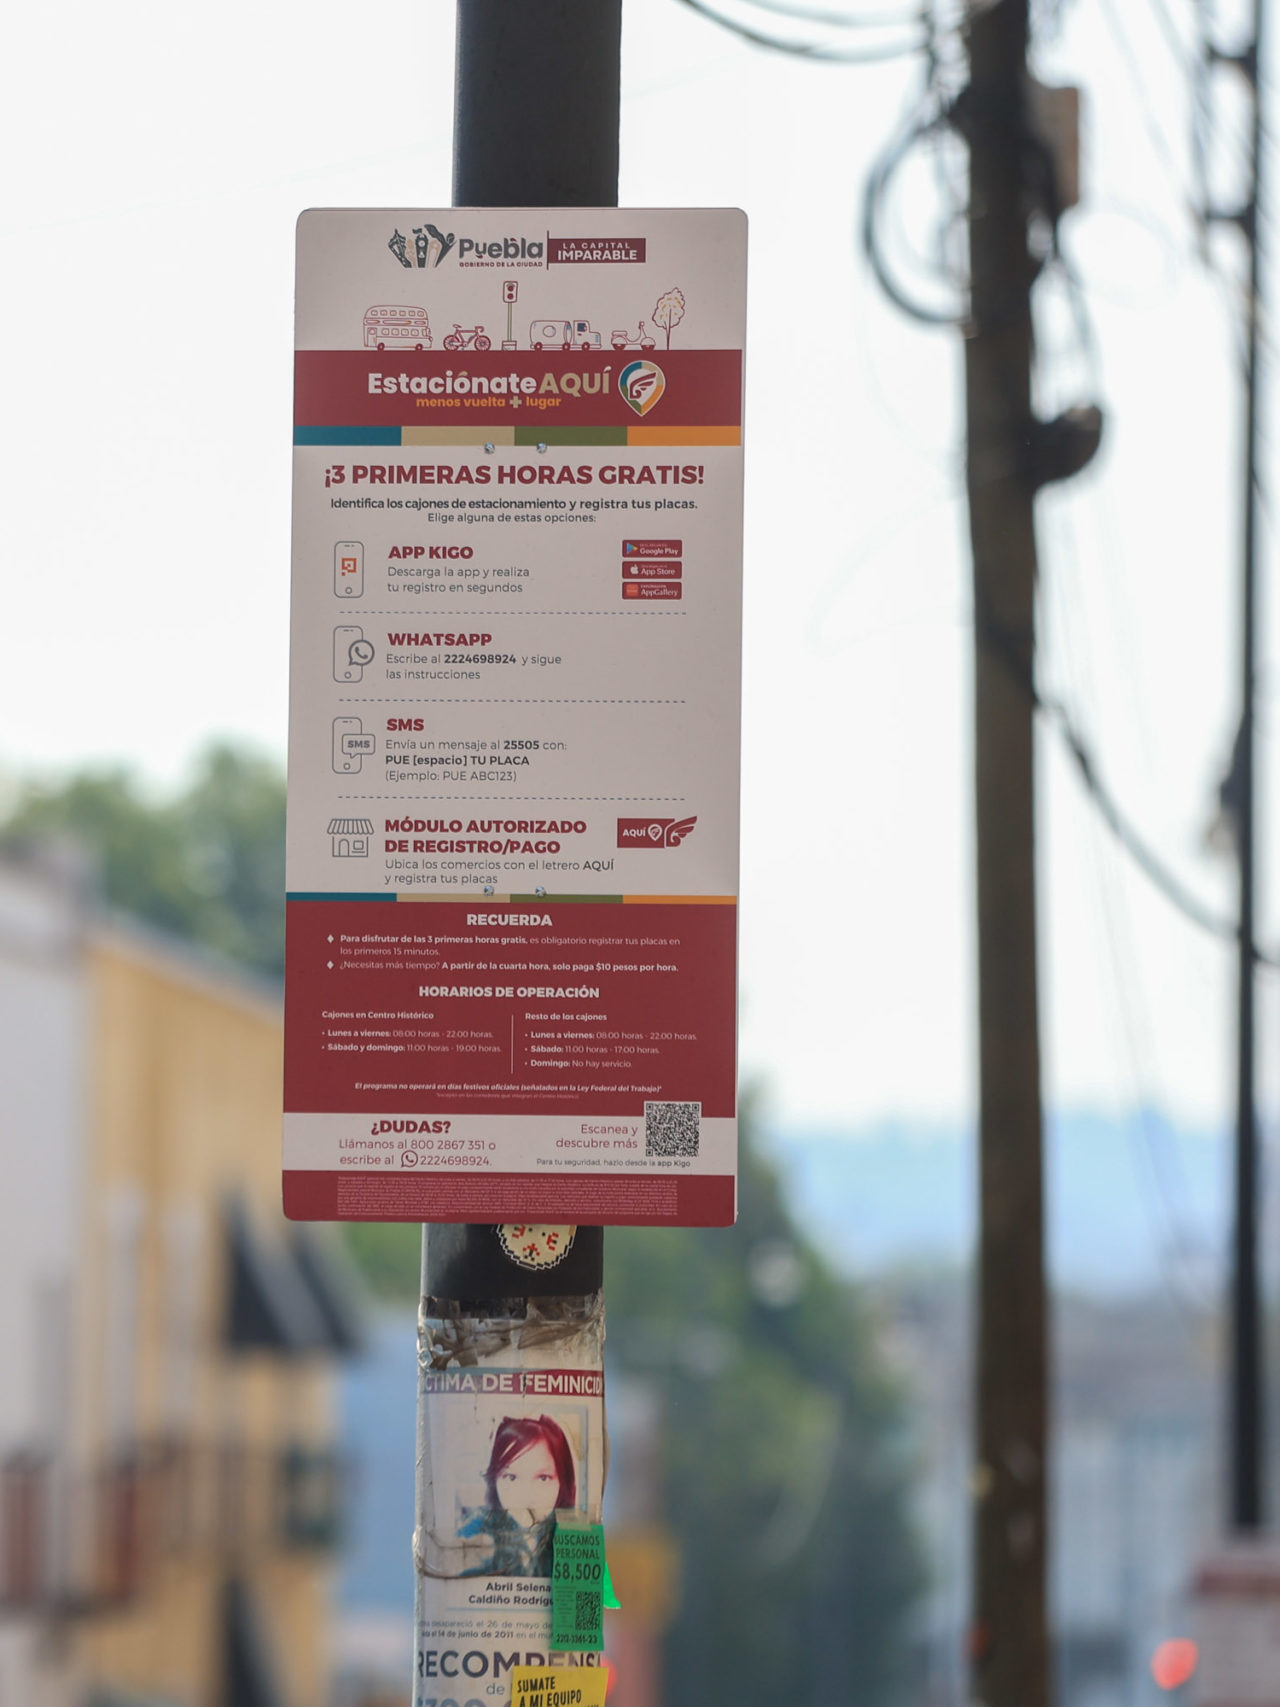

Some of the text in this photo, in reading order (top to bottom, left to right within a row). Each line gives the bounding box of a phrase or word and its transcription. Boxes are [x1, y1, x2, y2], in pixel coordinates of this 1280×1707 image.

[459, 237, 543, 260] Puebla
[562, 242, 631, 250] LA CAPITAL
[557, 250, 638, 261] IMPARABLE
[416, 397, 562, 410] menos vuelta lugar
[324, 464, 704, 488] ¡3 PRIMERAS HORAS GRATIS!
[330, 497, 698, 511] Identifica los cajones de estacionamiento y registra tus placas.
[427, 512, 596, 524] Elige alguna de estas opciones:
[388, 546, 473, 559] APP KIGO
[640, 548, 663, 556] Google
[387, 566, 529, 579] Descarga la app y realiza
[641, 568, 655, 576] App
[387, 582, 522, 594] tu registro en segundos
[387, 633, 492, 646] WHATSAPP
[386, 653, 561, 666] Escribe al 2224698924 y sigue
[386, 669, 480, 679] las instrucciones
[386, 718, 424, 731] SMS
[347, 740, 370, 749] SMS
[385, 739, 567, 751] Envía un mensaje al 25505 con:
[385, 754, 529, 767] PUE [espacio] TU PLACA
[385, 770, 516, 782] (Ejemplo: PUE ABC123)
[384, 816, 586, 833] MÓDULO AUTORIZADO
[622, 827, 646, 837] AQUÍ
[384, 838, 560, 854] DE REGISTRO/PAGO
[385, 858, 615, 871] Ubica los comercios con el letrero AQUÍ
[384, 873, 498, 885] y registra tus placas
[466, 913, 552, 926] RECUERDA
[340, 934, 359, 944] Para
[361, 934, 399, 944] disfrutar
[400, 935, 412, 943] de
[413, 935, 426, 943] las
[427, 935, 433, 944] 3
[434, 935, 474, 945] primeras
[474, 935, 500, 944] horas
[500, 935, 528, 946] gratis,
[540, 936, 586, 946] obligatorio
[588, 937, 623, 946] registrar
[640, 937, 667, 946] placas
[339, 961, 678, 973] ¿Necesitas más tiempo? A partir de la cuarta hora, solo paga $10 pesos por hora.
[418, 984, 599, 998] HORARIOS DE OPERACIÓN
[370, 1120, 451, 1135] ¿DUDAS?
[580, 1124, 638, 1136] Escanea y
[338, 1138, 496, 1150] Llámanos al 800 2867 351 o
[555, 1137, 638, 1148] descubre más
[339, 1154, 491, 1166] escribe al 2224698924.
[483, 1374, 513, 1391] DE
[520, 1374, 603, 1395] FEMINICID
[554, 1535, 600, 1546] BUSCAMOS
[556, 1548, 600, 1559] PERSONAL
[554, 1562, 601, 1583] $8,500
[486, 1582, 552, 1592] Abril Selena
[458, 1630, 514, 1640] junio de 2011
[486, 1683, 505, 1695] de
[517, 1677, 556, 1694] SUMATE
[547, 1689, 582, 1707] EQUIPO
